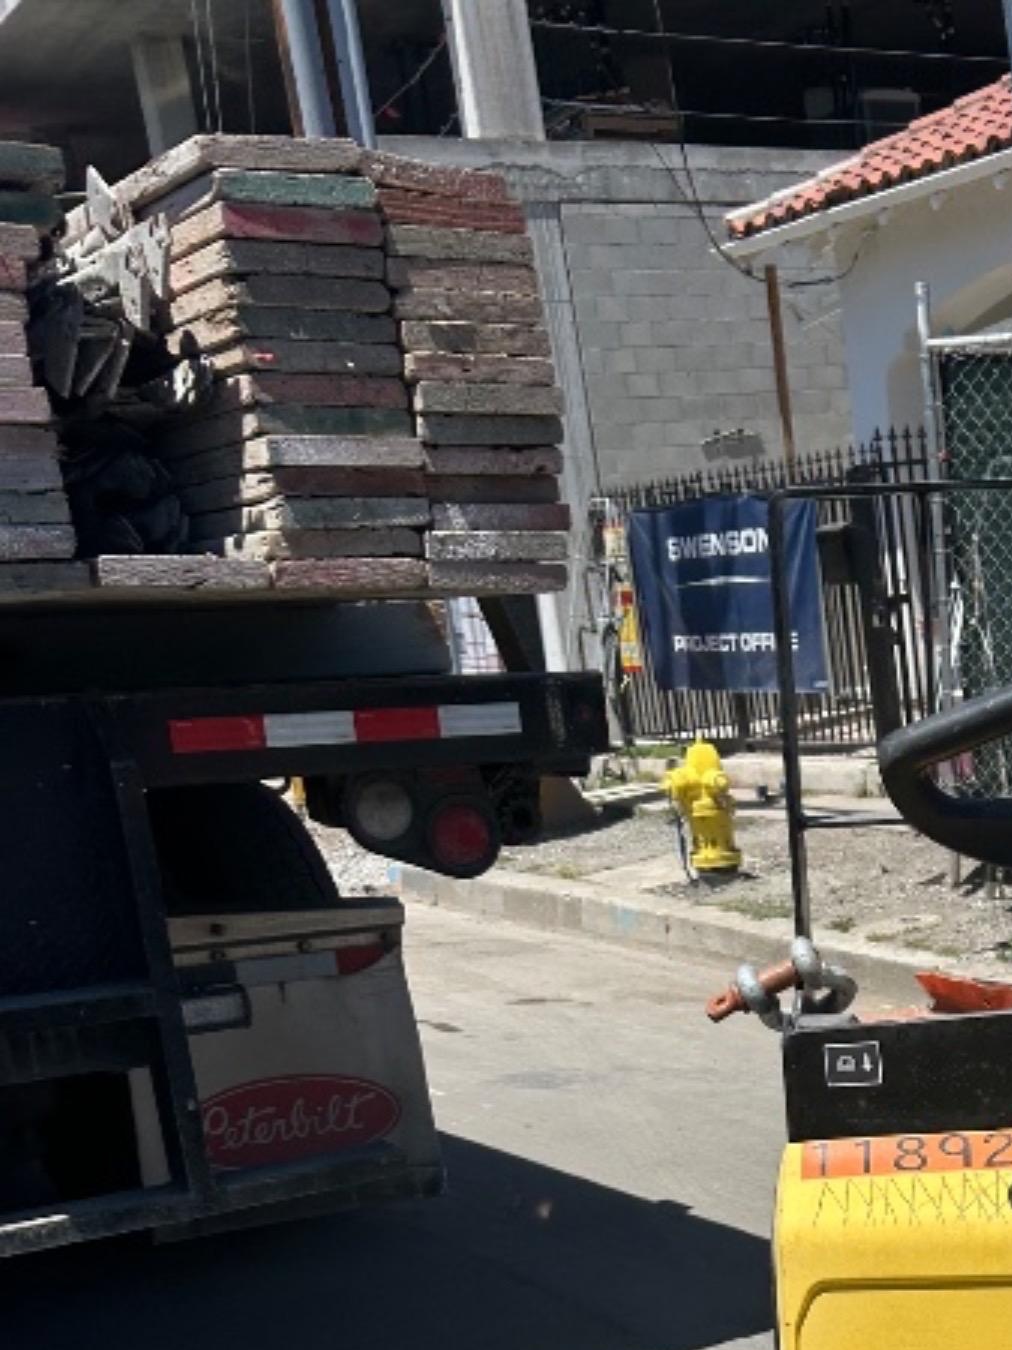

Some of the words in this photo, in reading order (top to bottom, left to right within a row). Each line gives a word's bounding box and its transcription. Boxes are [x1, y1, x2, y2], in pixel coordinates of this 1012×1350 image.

[673, 633, 737, 652] PROJECT
[739, 630, 800, 653] OFFIE
[204, 1091, 377, 1150] Peterbilt
